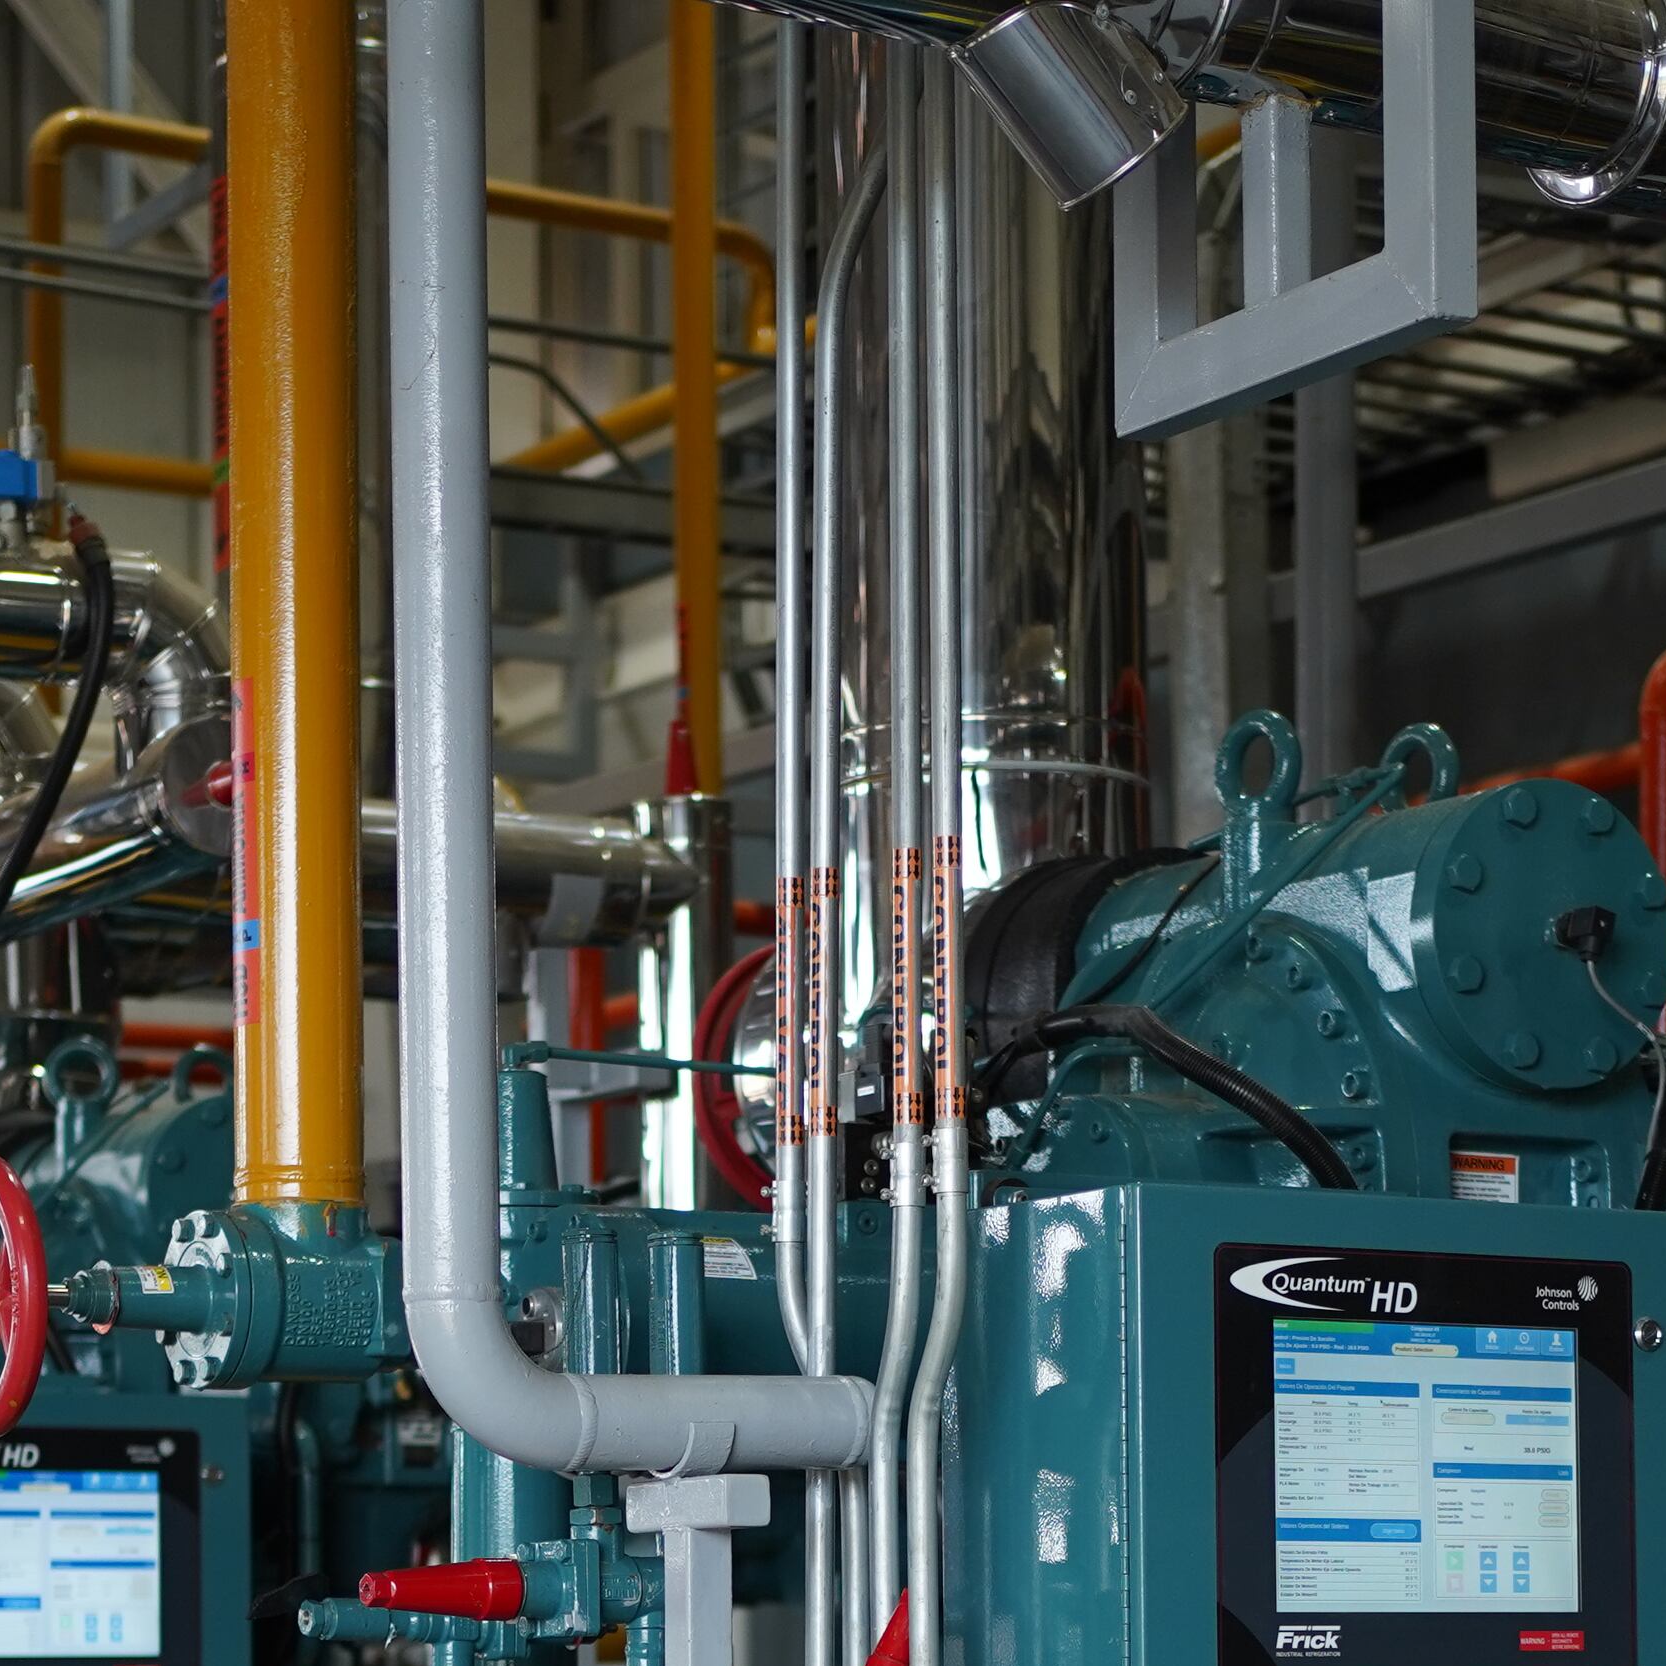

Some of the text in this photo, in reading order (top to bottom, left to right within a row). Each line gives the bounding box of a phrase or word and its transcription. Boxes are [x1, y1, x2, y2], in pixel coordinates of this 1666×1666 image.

[1453, 1157, 1505, 1171] WARNING
[1370, 1281, 1418, 1314] HD
[1535, 1285, 1573, 1298] Johnson
[1542, 1299, 1580, 1311] Controls
[2, 1443, 41, 1468] HD
[1276, 1626, 1341, 1649] Frick
